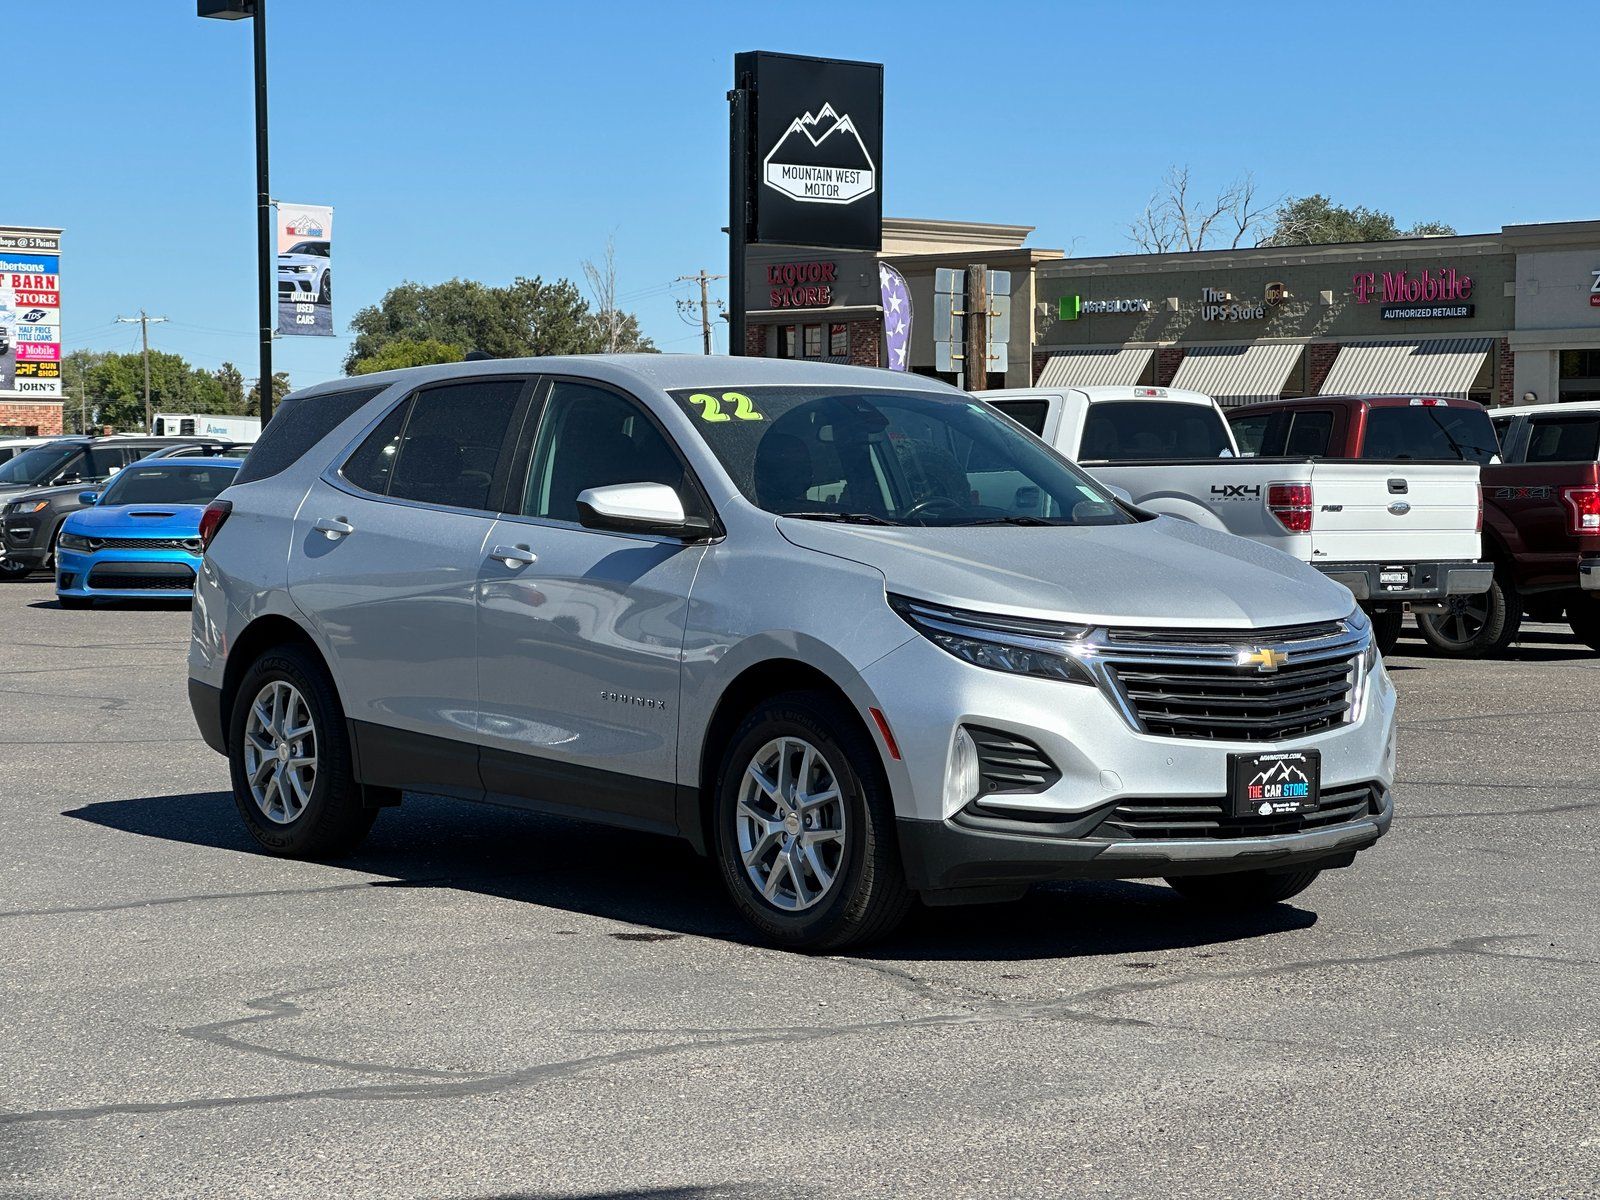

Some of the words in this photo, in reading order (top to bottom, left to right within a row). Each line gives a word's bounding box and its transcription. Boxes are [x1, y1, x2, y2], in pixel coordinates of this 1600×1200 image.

[782, 166, 833, 182] MOUNTAIN
[835, 170, 861, 184] WEST
[804, 182, 840, 196] MOTOR
[29, 238, 35, 246] 5
[35, 239, 56, 248] Points
[767, 261, 834, 286] LIQUOR
[11, 275, 56, 289] BARN
[15, 293, 57, 304] STORE
[290, 291, 319, 302] QUALITY
[769, 286, 831, 307] STORE
[1201, 287, 1225, 302] The
[1266, 289, 1280, 303] ups
[296, 303, 315, 313] USED
[1081, 300, 1105, 313] H&R
[1106, 299, 1149, 312] BLOCK
[1201, 306, 1228, 321] UPS
[1230, 304, 1264, 320] Store
[1384, 308, 1432, 318] AUTHORIZED
[1432, 307, 1467, 317] RETAILER
[27, 312, 42, 320] TDS
[296, 314, 315, 325] CARS
[33, 334, 53, 342] LOANS
[19, 383, 56, 391] JOHN'S
[689, 392, 763, 422] 22
[1211, 484, 1260, 496] 4X4
[600, 691, 666, 710] EQUINOX
[1248, 785, 1263, 799] THE
[1264, 784, 1282, 797] CAR
[1283, 783, 1308, 796] STORE
